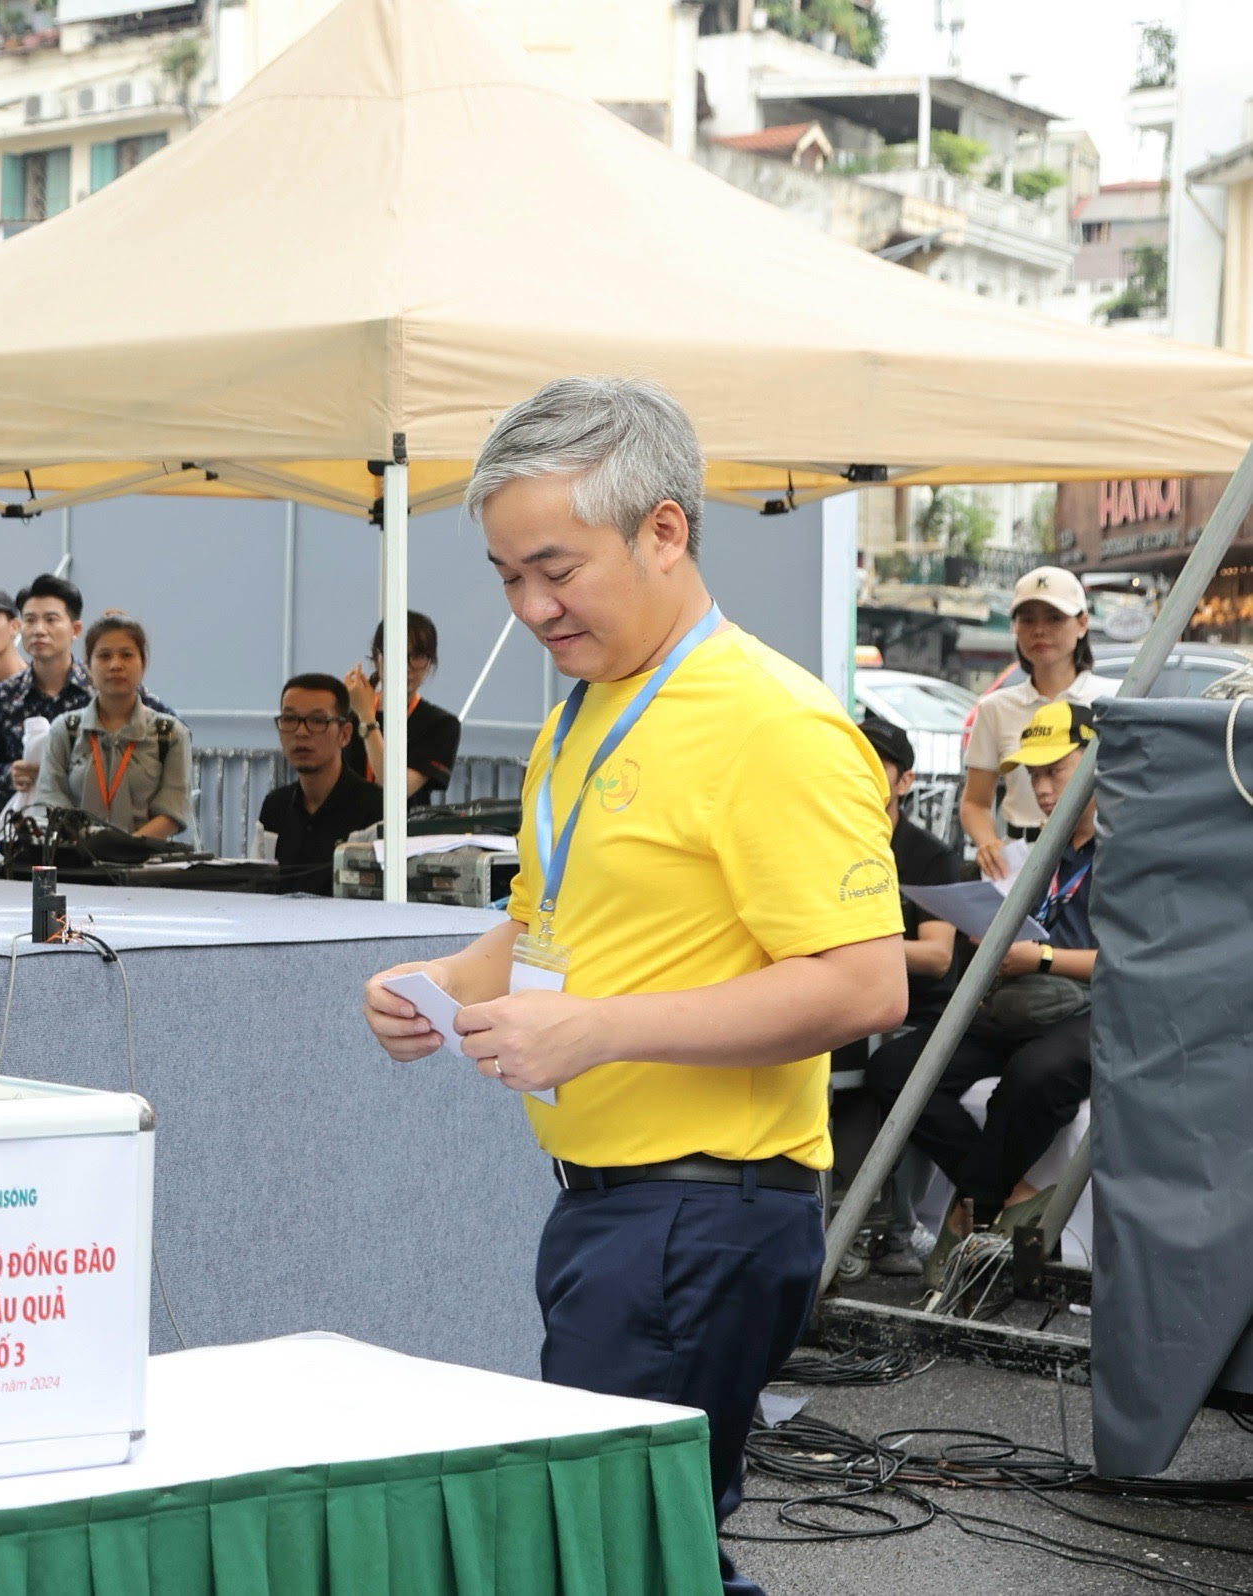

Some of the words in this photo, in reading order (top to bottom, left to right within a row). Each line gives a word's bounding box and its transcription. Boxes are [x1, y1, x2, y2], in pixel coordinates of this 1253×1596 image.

[7, 1243, 68, 1278] ĐỒNG
[74, 1242, 116, 1274] BÀO
[22, 1285, 65, 1325] QUẢ
[14, 1342, 26, 1367] 3
[1, 1379, 27, 1393] năm
[29, 1375, 61, 1391] 2024
